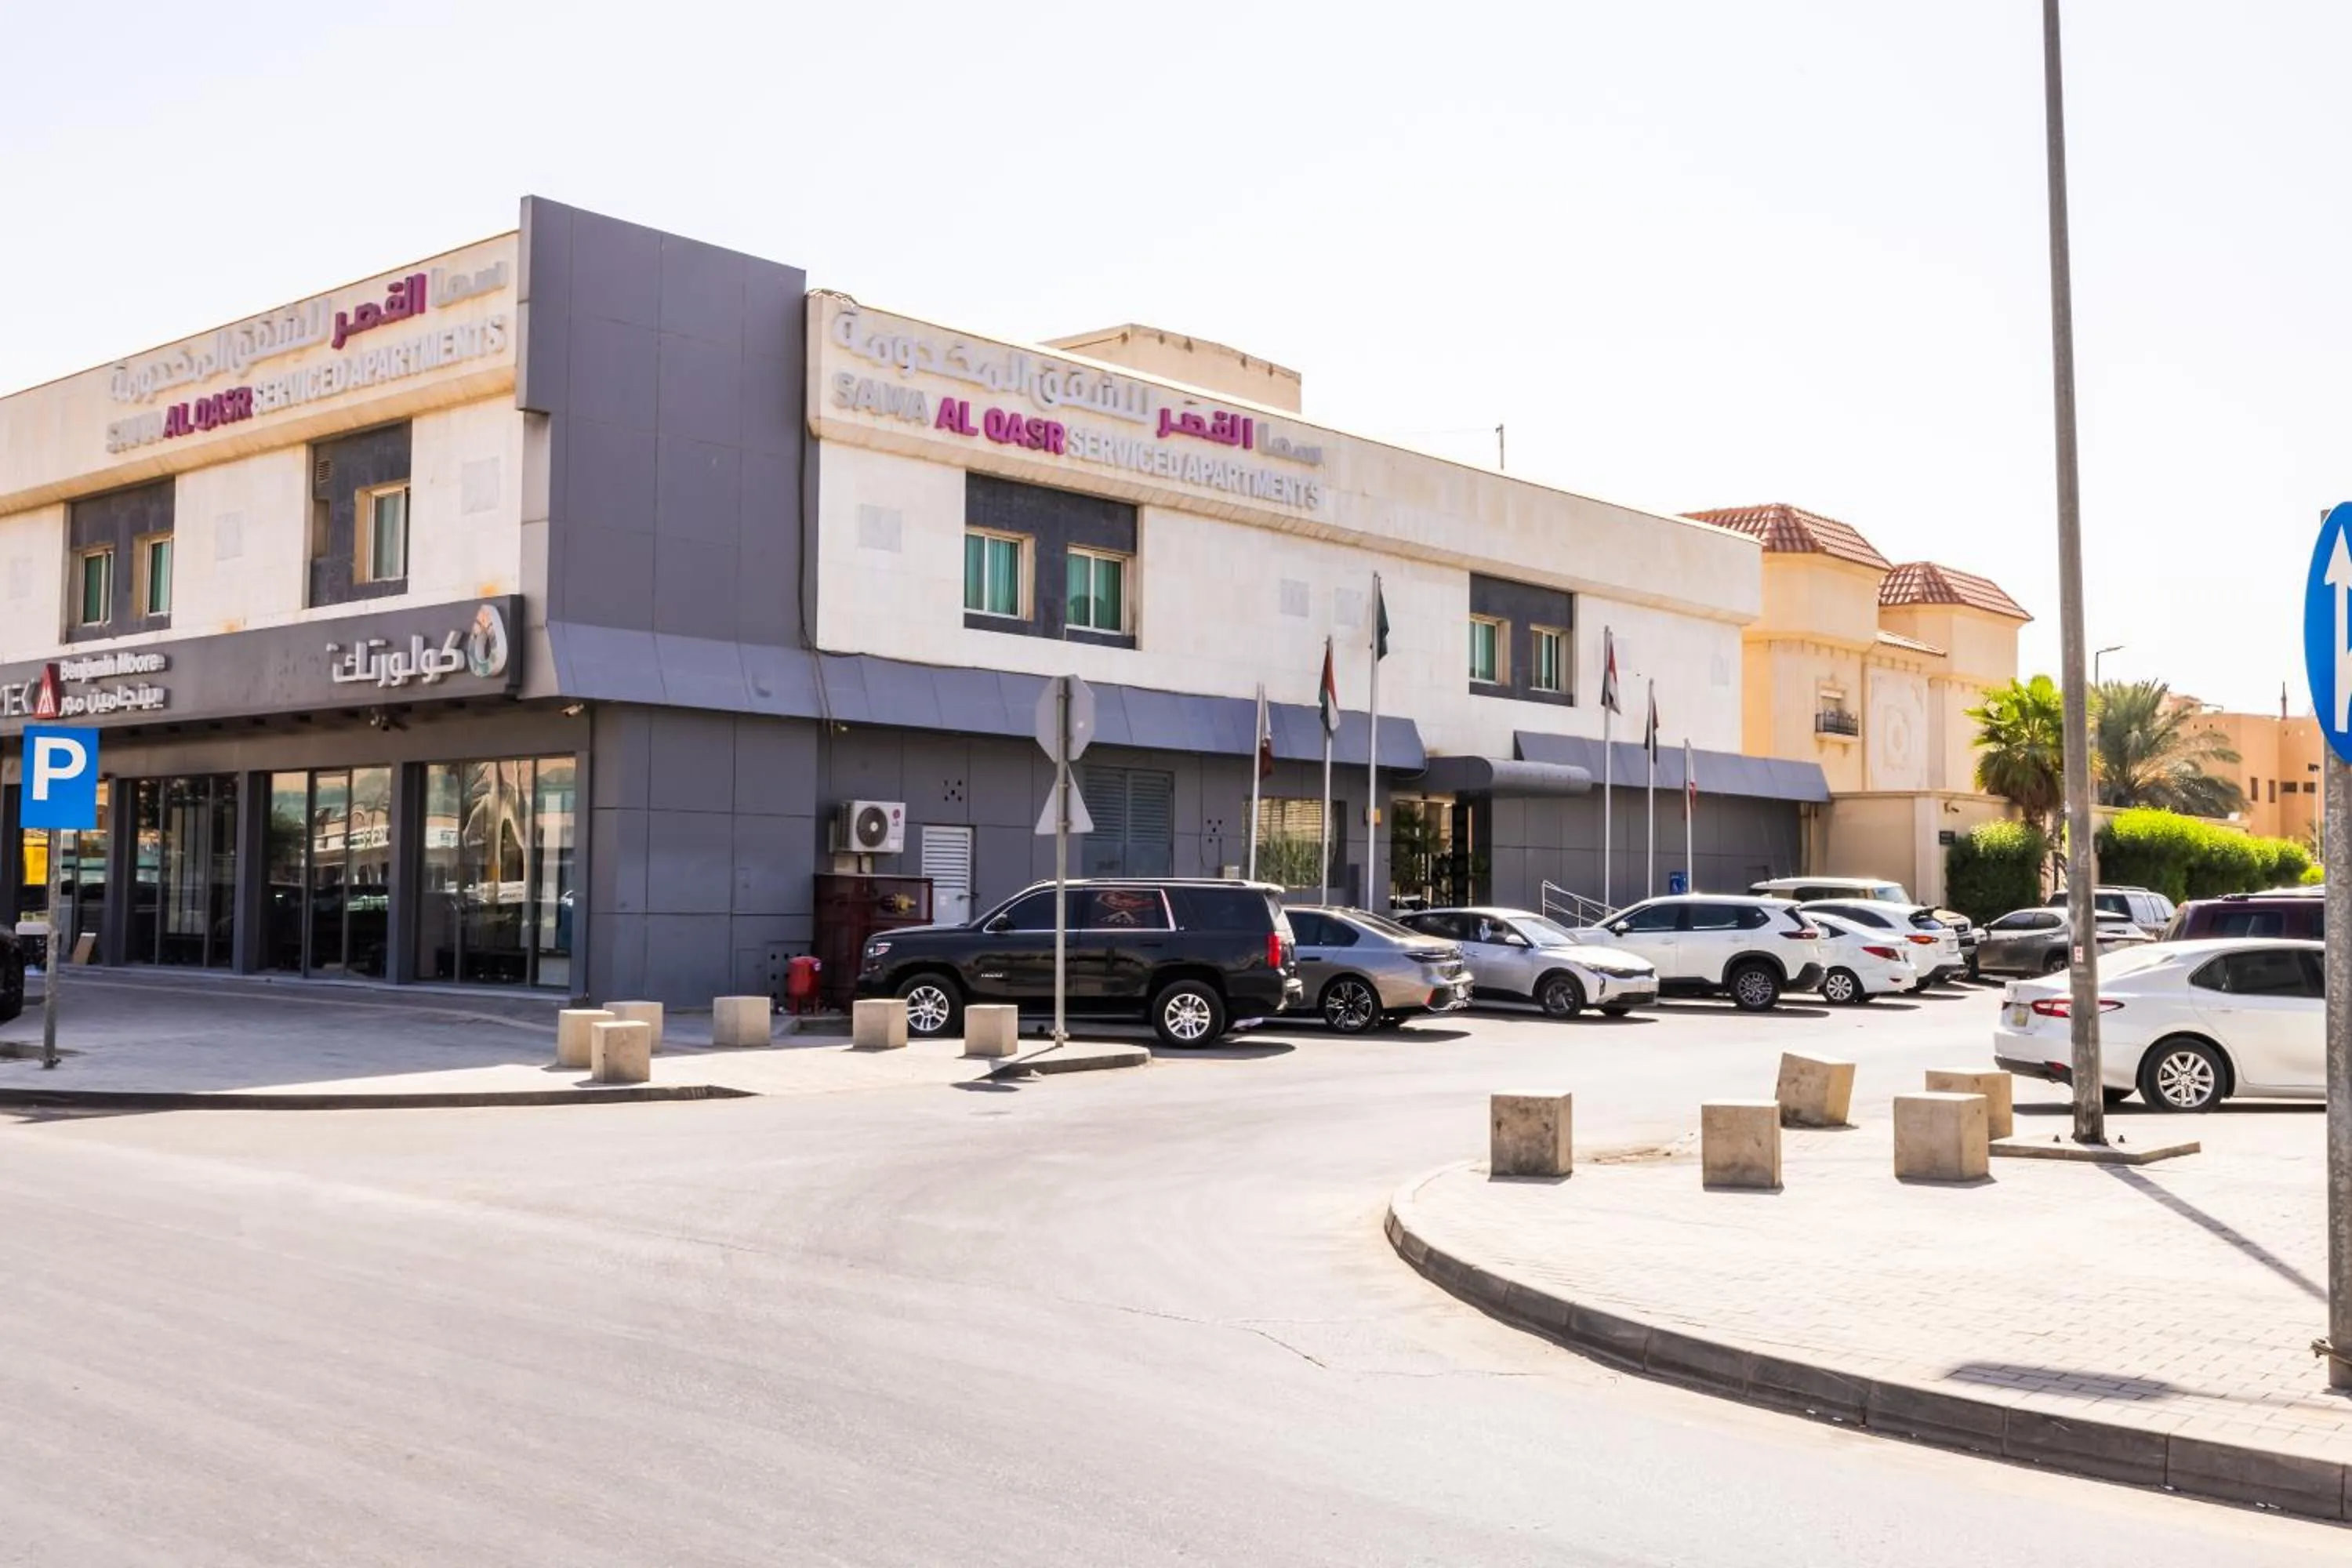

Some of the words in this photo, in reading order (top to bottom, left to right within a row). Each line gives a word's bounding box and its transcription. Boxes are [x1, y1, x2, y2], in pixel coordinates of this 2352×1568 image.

[332, 273, 426, 350] القصر
[163, 403, 194, 438] AL
[195, 387, 253, 430] QASR
[252, 358, 350, 415] SERVICED
[349, 314, 506, 387] APARTMENTS
[935, 397, 978, 436] AL
[984, 408, 1065, 455] QASR
[1066, 428, 1182, 477] SERVICED
[1181, 453, 1322, 510] APARTMENTS
[1156, 408, 1253, 450] القصر
[1258, 423, 1323, 466] سما
[60, 655, 116, 683] Benjamin
[117, 652, 165, 675] Moore
[332, 630, 465, 688] كولورتك
[32, 736, 87, 801] P
